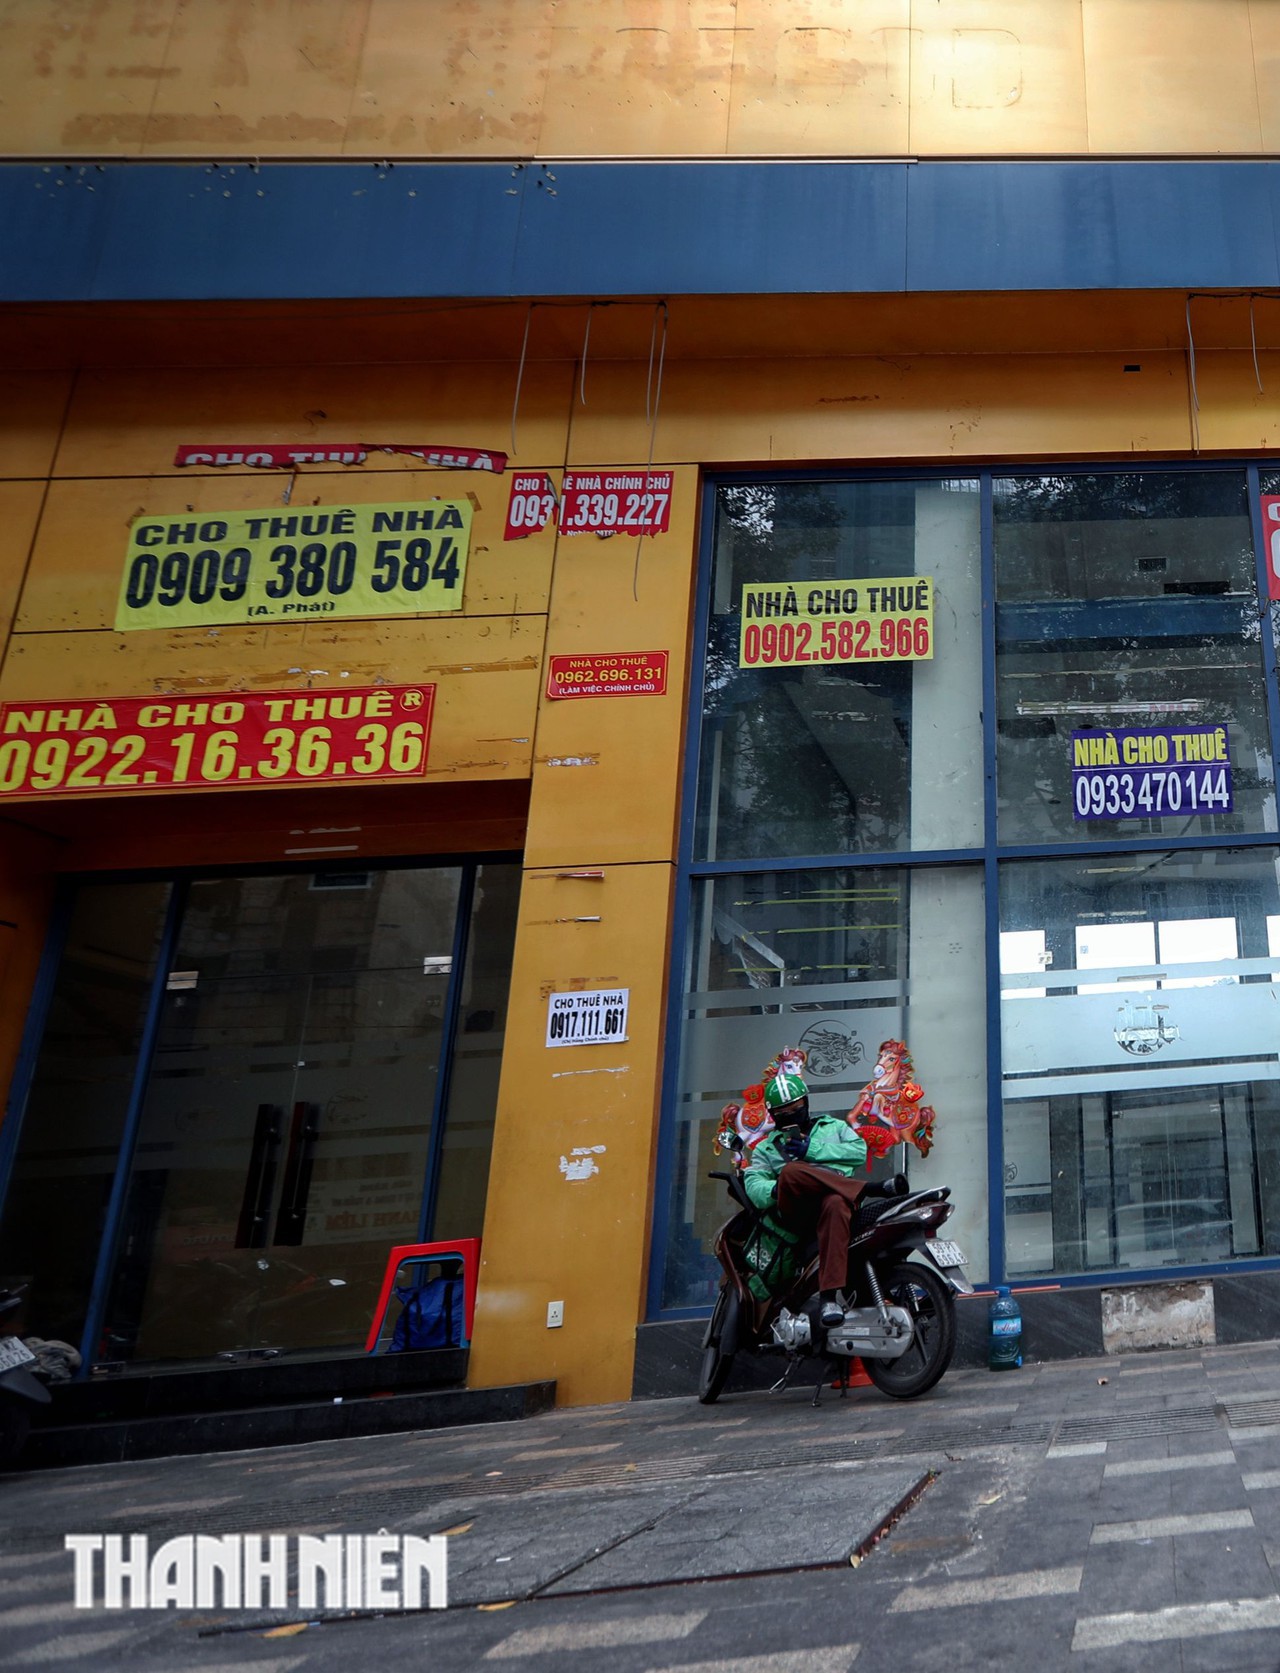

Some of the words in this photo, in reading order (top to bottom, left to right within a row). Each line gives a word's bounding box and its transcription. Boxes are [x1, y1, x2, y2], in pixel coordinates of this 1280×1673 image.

[515, 478, 540, 491] CHO
[576, 475, 601, 490] NHÀ
[605, 475, 643, 490] CHÍNH
[646, 473, 670, 490] CHỦ
[135, 520, 229, 547] CHO
[245, 508, 357, 540] THUÊ
[371, 504, 465, 533] NHÀ
[125, 547, 252, 609] 0909
[265, 541, 358, 599] 380
[370, 537, 460, 593] 584
[247, 604, 276, 618] (A.
[281, 601, 336, 615] Phát)
[746, 586, 799, 618] NHÀ
[807, 588, 858, 616] CHO
[866, 579, 930, 613] THUÊ
[744, 616, 930, 665] 0902.582.966
[555, 667, 662, 684] 0962.696.131
[569, 657, 593, 669] NHÀ
[594, 657, 618, 668] CHO
[619, 655, 648, 666] THUÊ
[558, 685, 581, 695] (LÀM
[582, 684, 602, 694] VIỆC
[604, 682, 632, 693] CHÍNH
[633, 681, 655, 692] CHỦ)
[3, 703, 118, 734] NHÀ
[137, 700, 246, 729] CHO
[264, 690, 394, 723] THUÊ
[0, 721, 425, 792] 0922.16.36.36
[1074, 732, 1120, 767] NHÀ
[1122, 735, 1169, 764] CHO
[1171, 727, 1228, 762] THUÊ
[1185, 768, 1230, 810] 144
[554, 998, 574, 1009] CHO
[576, 993, 600, 1008] THUÊ
[602, 991, 624, 1006] NHÀ
[550, 1008, 625, 1039] 0917.111.661
